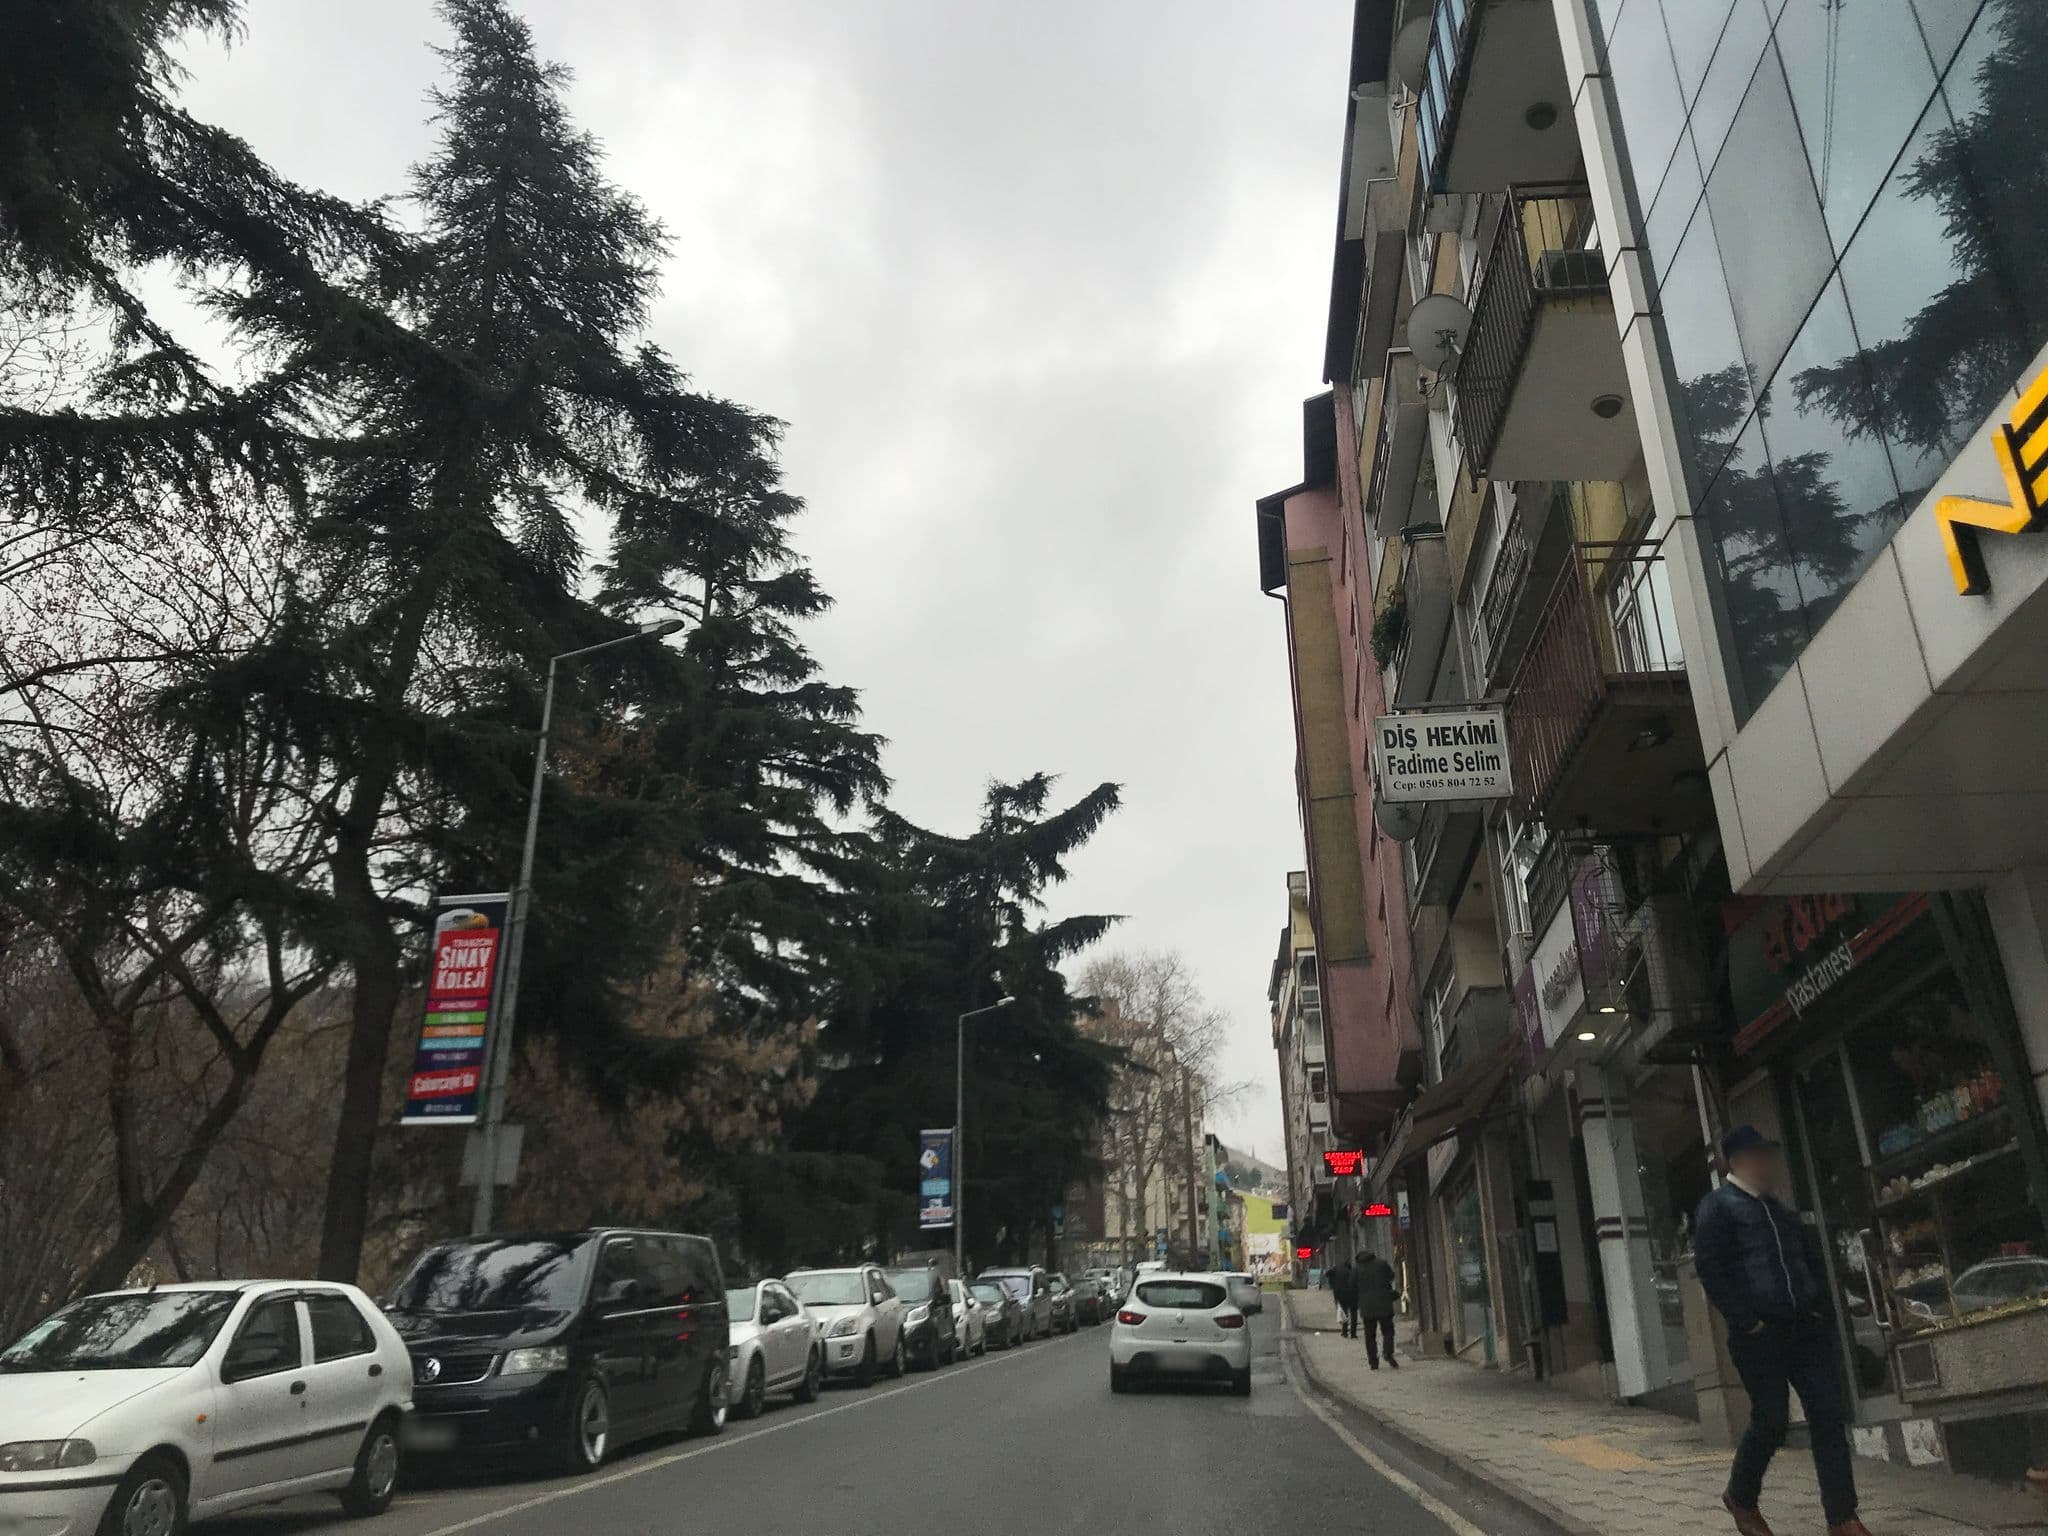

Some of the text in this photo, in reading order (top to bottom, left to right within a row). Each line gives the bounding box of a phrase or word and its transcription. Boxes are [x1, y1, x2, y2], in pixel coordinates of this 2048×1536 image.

[1383, 719, 1498, 751] DİŞ HEKİMİ
[1387, 750, 1501, 775] Fadime Selim
[1393, 776, 1496, 792] Cep: 0505 804 72 52
[439, 947, 491, 969] SINAV
